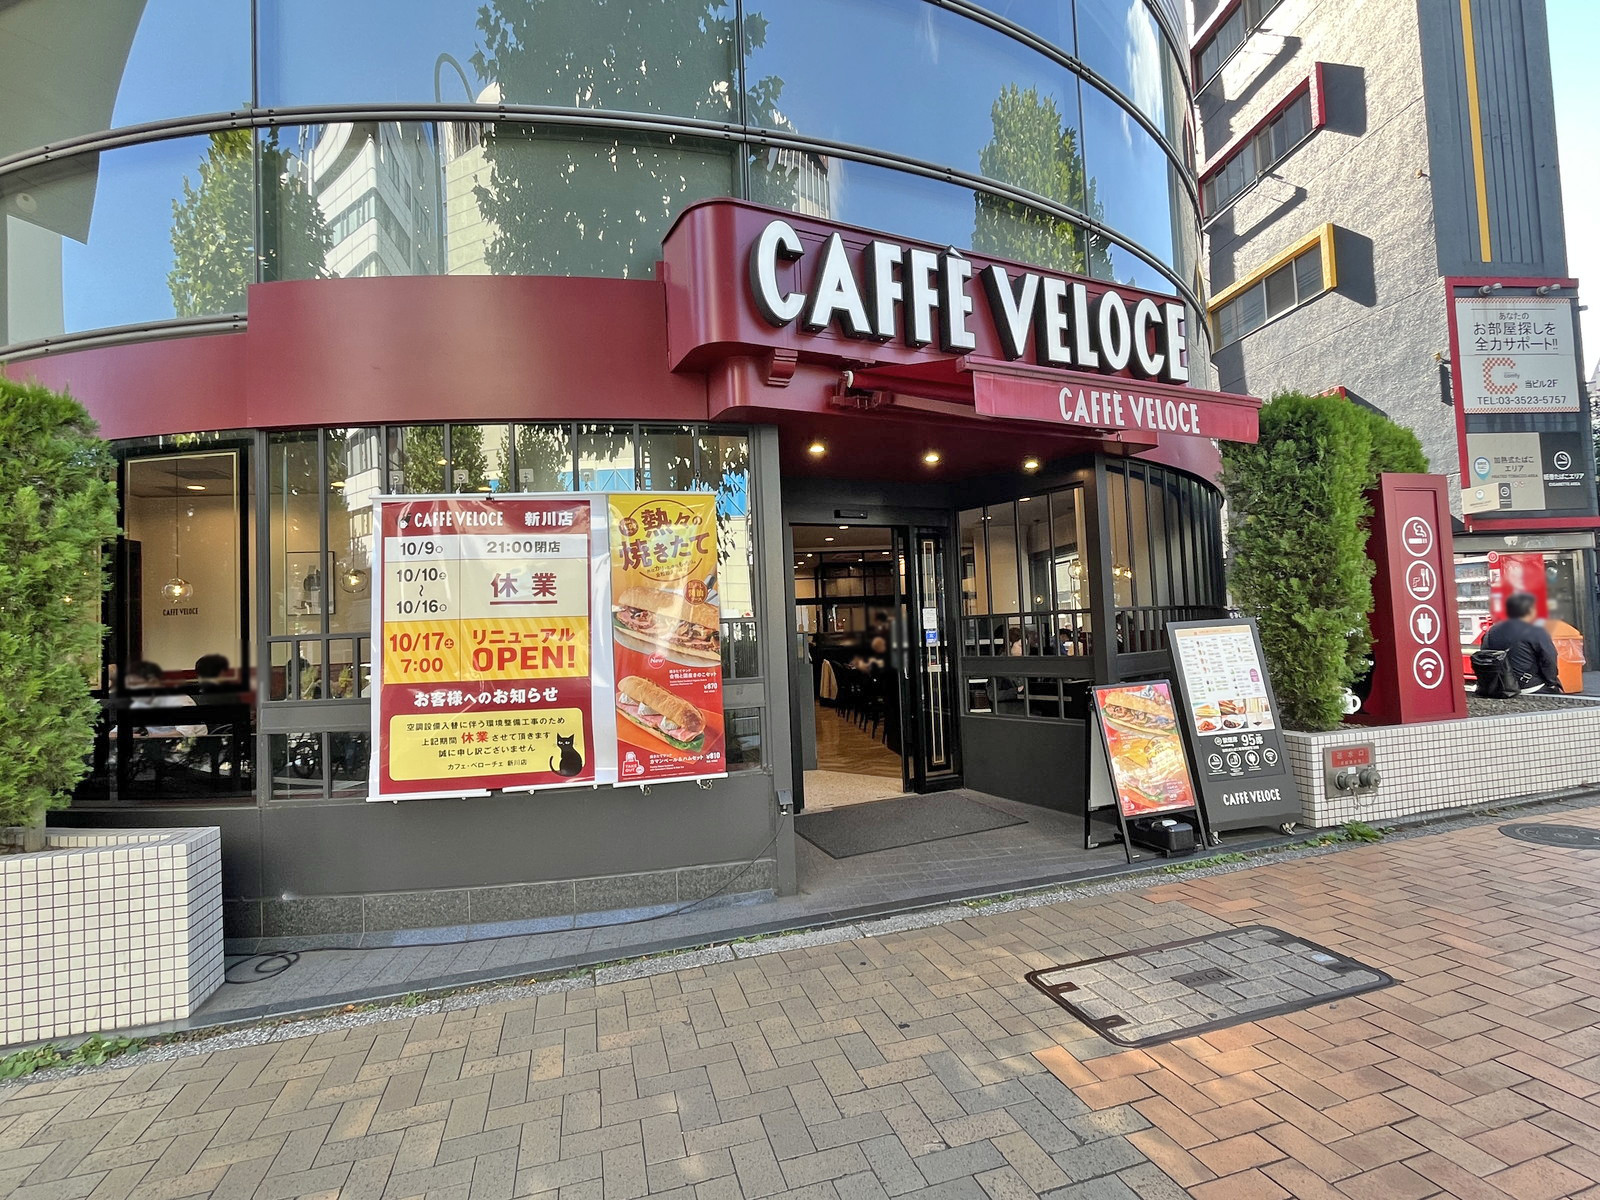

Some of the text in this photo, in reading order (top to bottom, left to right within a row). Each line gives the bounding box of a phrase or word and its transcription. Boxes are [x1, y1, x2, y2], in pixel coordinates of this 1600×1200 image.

[751, 219, 1189, 382] CAFFÈ VELOCE
[1499, 312, 1529, 320] あなたの
[1474, 321, 1556, 335] お部屋探しを
[1525, 379, 1559, 388] 当ビル2F
[1477, 395, 1567, 405] TEL:03-3523-5757
[1059, 387, 1200, 434] CAFFÈ VELOCE
[455, 511, 503, 527] VELOCE
[524, 511, 574, 528] 新川店
[641, 507, 703, 539] 熱々の
[487, 541, 560, 554] 21:00閉店
[619, 532, 710, 572] 焼きたて
[490, 572, 557, 598] 休業
[179, 607, 199, 615] VELOCE
[473, 628, 575, 646] リニューアル
[401, 658, 443, 673] 7:00
[472, 645, 575, 672] OPEN!
[414, 687, 559, 707] お客様へのお知らせ
[406, 717, 565, 731] 空調設備入替に伴う環境整備工事のため
[422, 731, 550, 747] 上記期間 休業 させて頂きます
[438, 744, 536, 758] 誠に申し訳ございません
[1249, 788, 1282, 803] VELOCE
